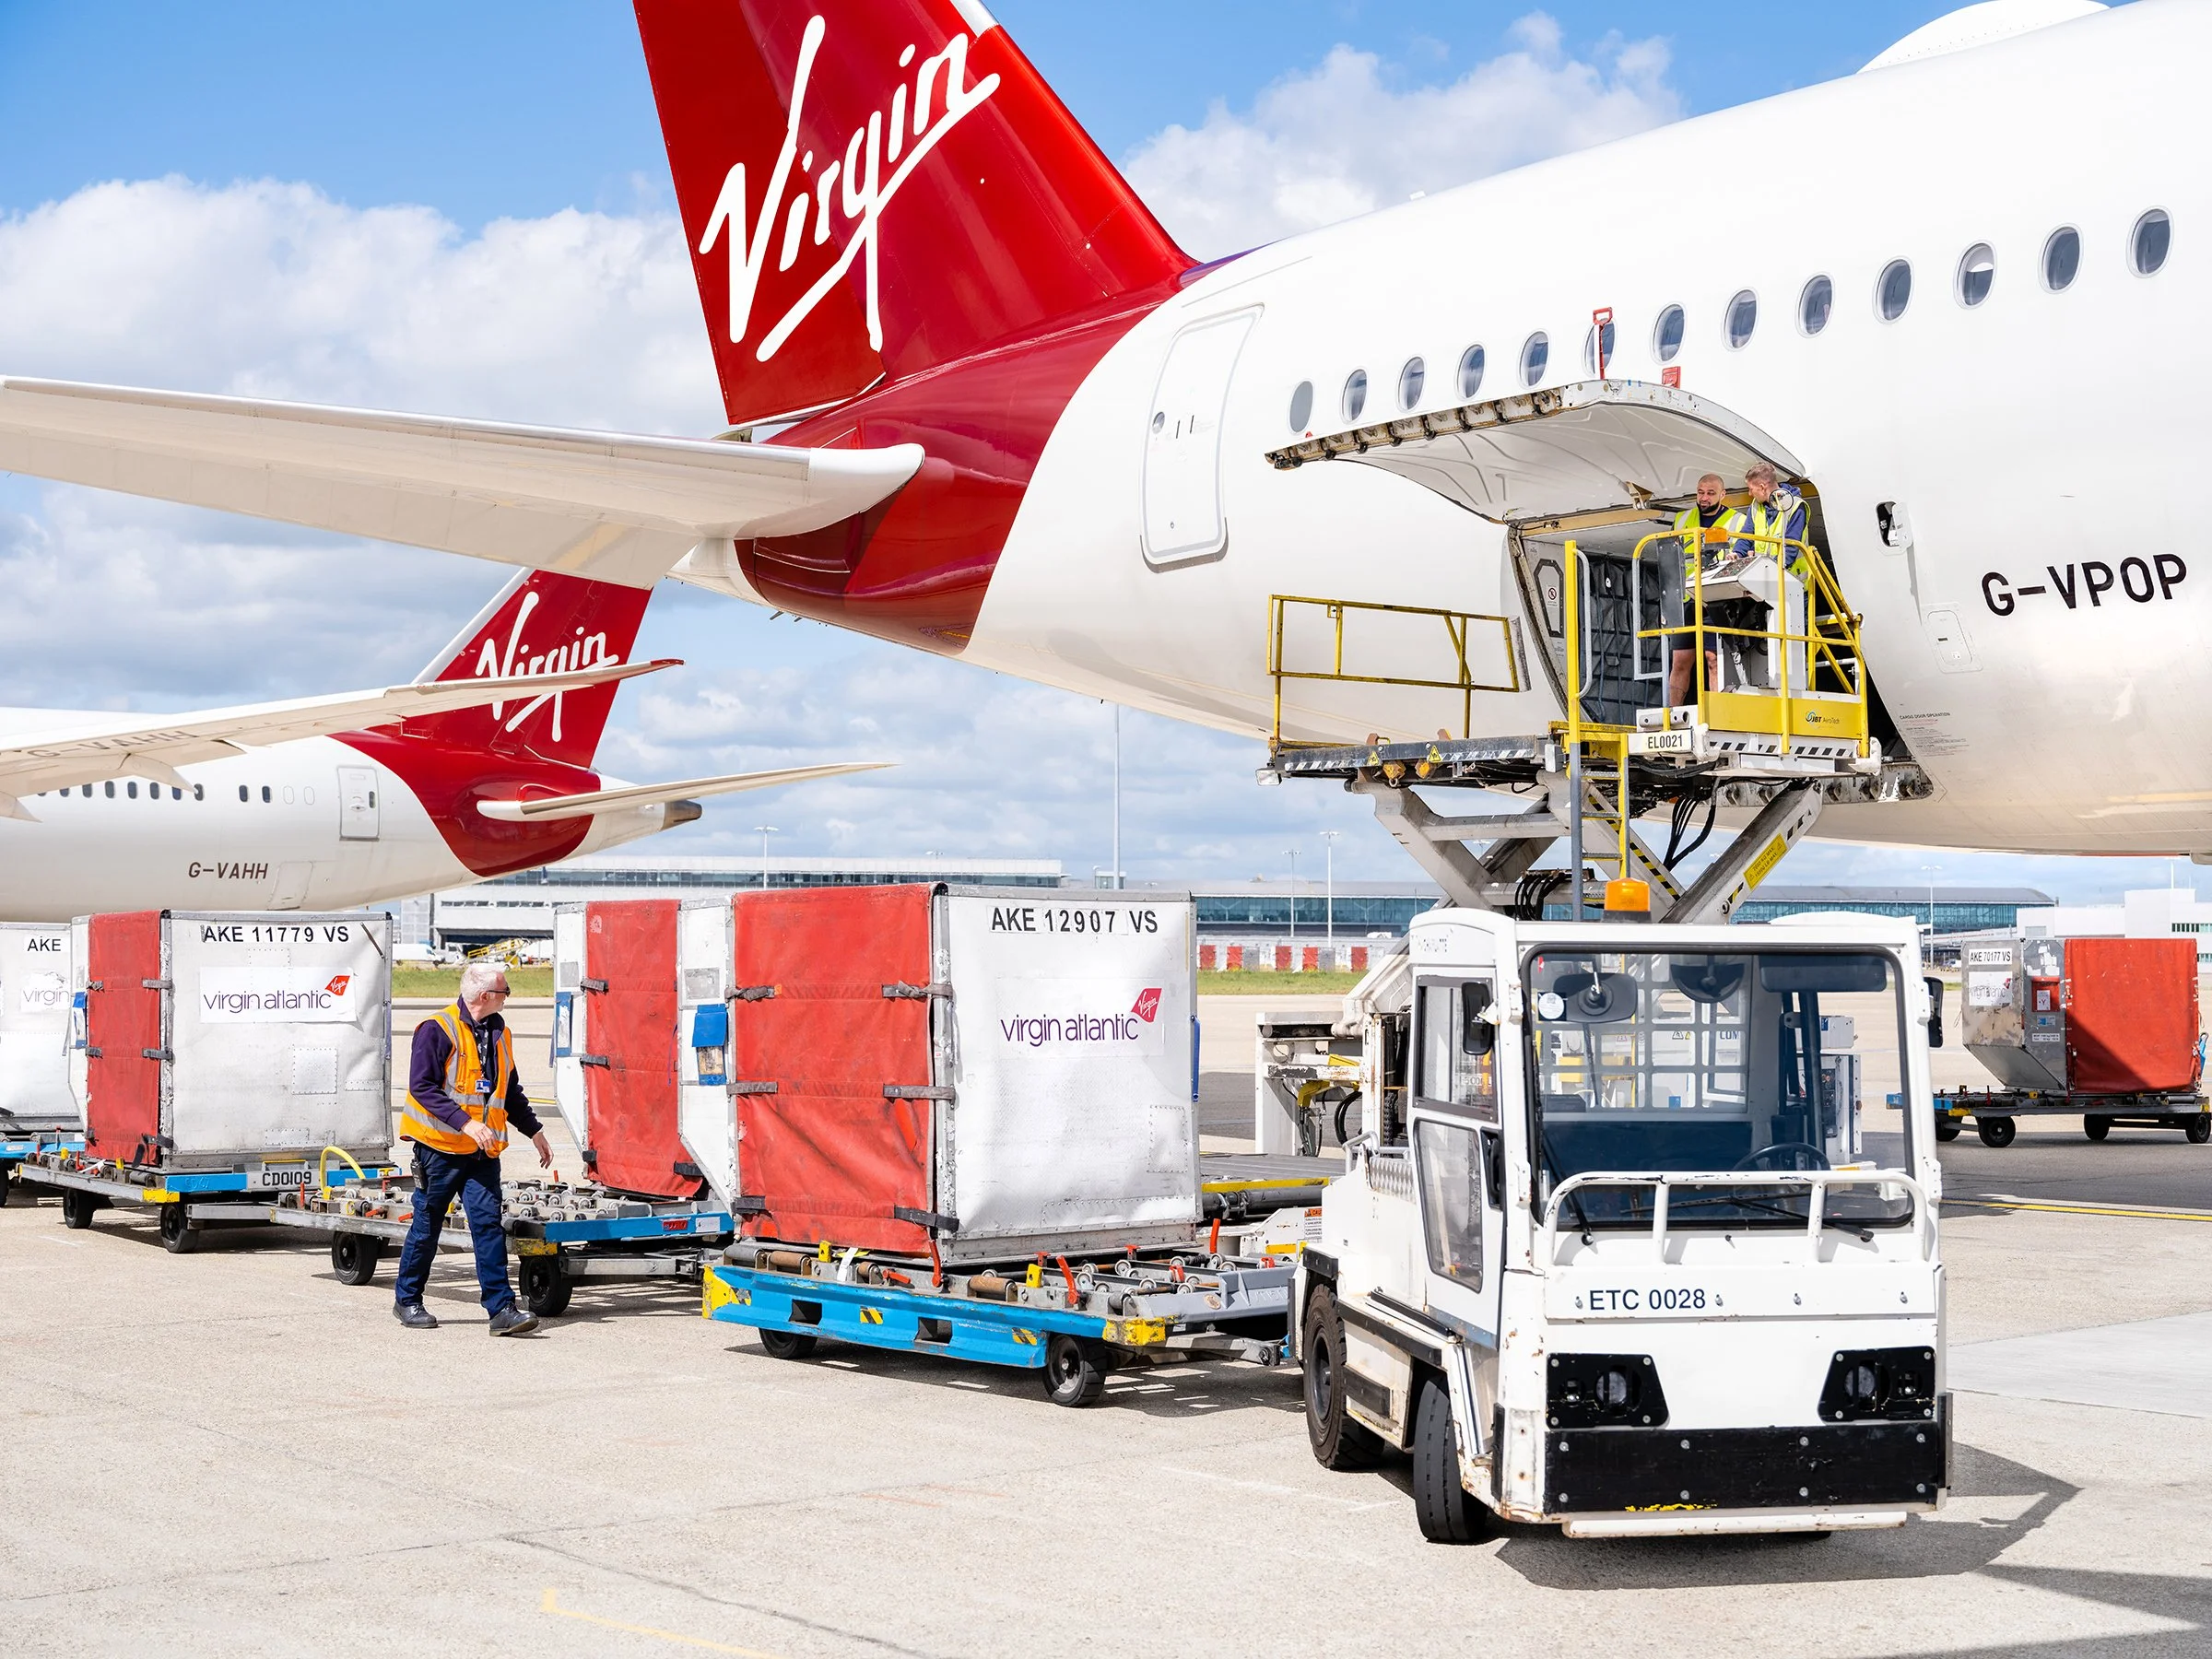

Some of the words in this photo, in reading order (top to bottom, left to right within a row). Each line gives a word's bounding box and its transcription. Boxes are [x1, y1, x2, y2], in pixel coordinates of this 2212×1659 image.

[699, 15, 1001, 362] Virgin
[1981, 553, 2187, 617] G-VPOP
[475, 591, 619, 742] Virgin
[27, 730, 200, 759] G-VAHH
[1647, 735, 1683, 749] EL0021
[188, 862, 269, 879] G-VAHH
[992, 907, 1037, 932] AKE
[1044, 909, 1115, 933] 12907
[1129, 910, 1159, 934] VS
[27, 938, 62, 952] AKE
[204, 925, 244, 942] AKE
[252, 926, 314, 942] 11779
[324, 925, 349, 942] VS
[1970, 952, 1983, 962] AKE
[1983, 951, 2001, 962] 70177
[2002, 951, 2011, 962] VS
[23, 987, 70, 1006] virgin
[203, 990, 261, 1013] virgin
[264, 990, 332, 1009] atlantic
[1137, 991, 1159, 1018] Virgin
[1000, 1014, 1062, 1047] virgin
[1065, 1014, 1139, 1041] atlantic
[262, 1171, 312, 1187] CD0109
[1589, 1289, 1640, 1311] ETC
[1649, 1288, 1706, 1310] 0028
